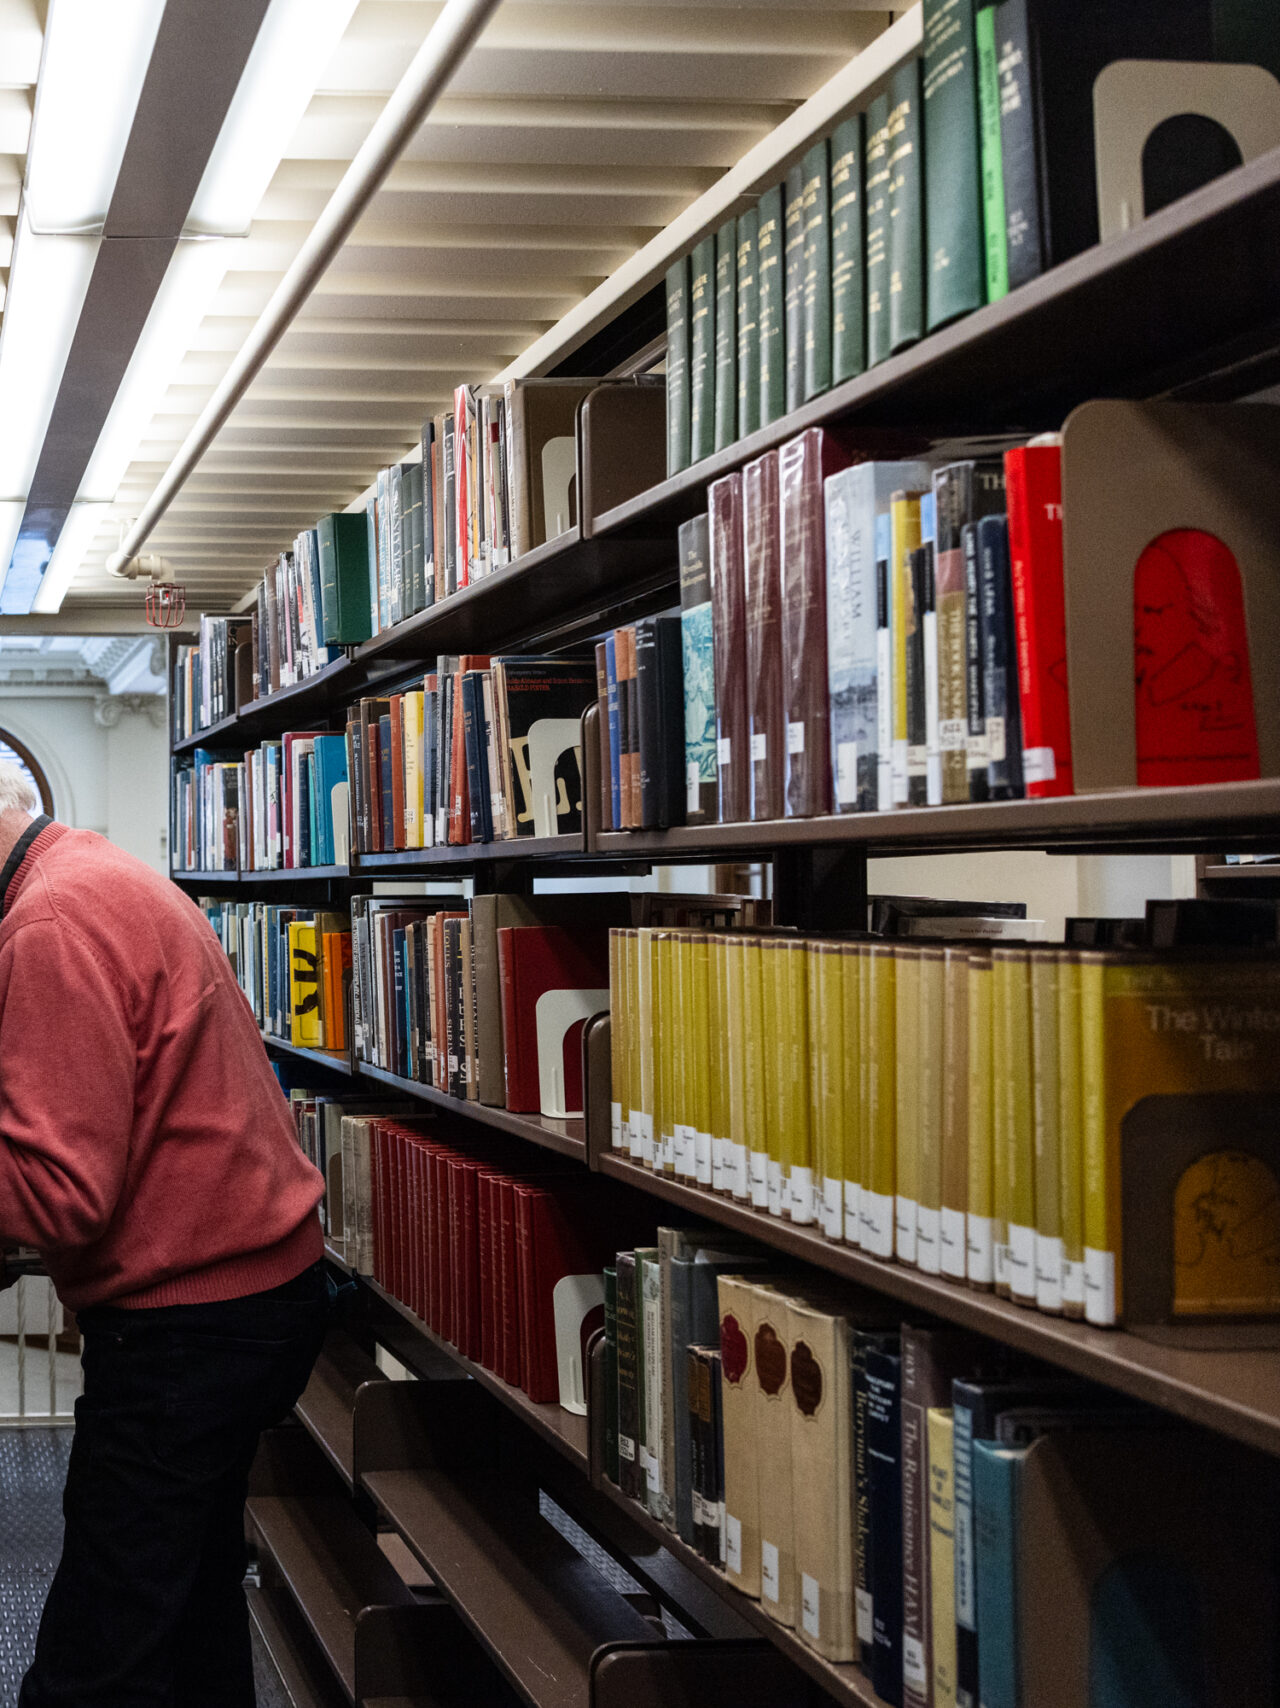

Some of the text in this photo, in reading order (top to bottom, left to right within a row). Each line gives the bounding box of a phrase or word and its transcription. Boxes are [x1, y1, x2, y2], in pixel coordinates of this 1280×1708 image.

[904, 1419, 919, 1446] The
[855, 1494, 870, 1589] Shakespear
[904, 1450, 920, 1570] Renaissance
